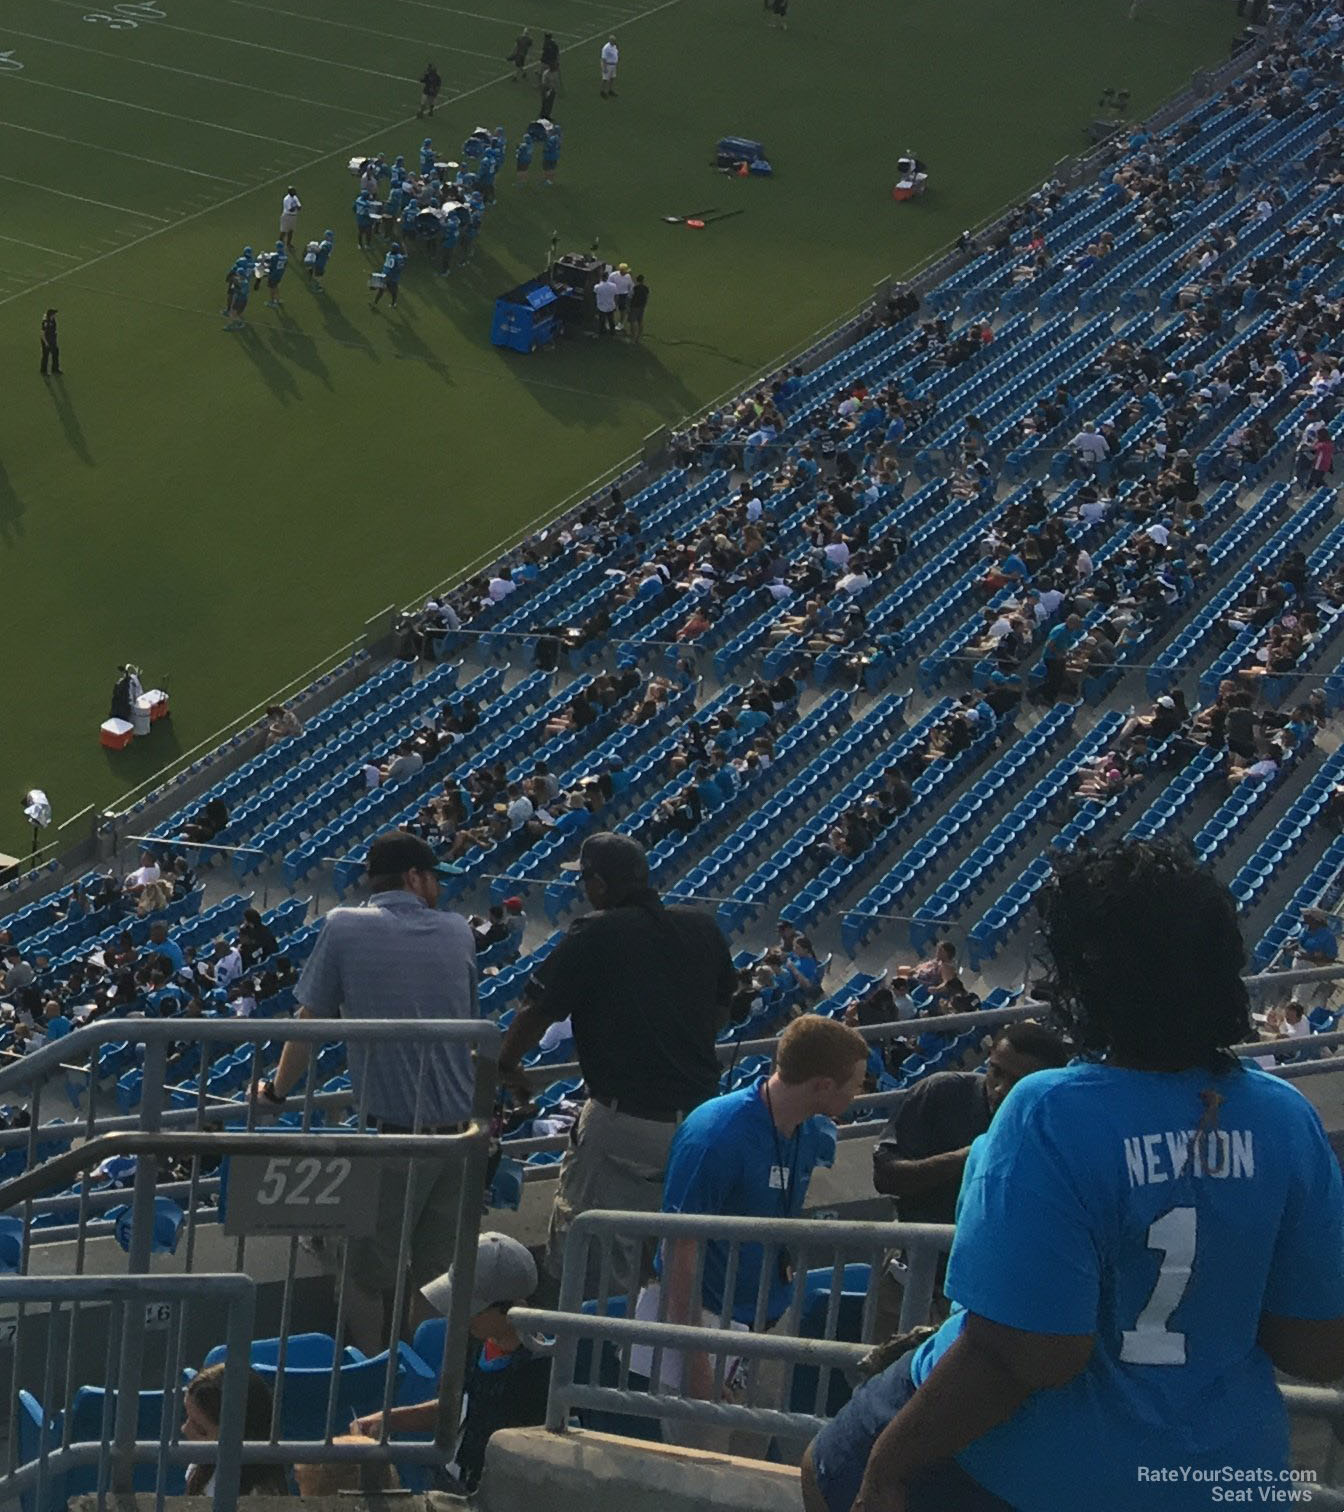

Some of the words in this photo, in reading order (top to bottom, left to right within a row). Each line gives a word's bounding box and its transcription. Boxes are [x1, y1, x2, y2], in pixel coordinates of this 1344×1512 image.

[82, 1, 167, 30] 30
[257, 1158, 352, 1205] 522
[1124, 1130, 1255, 1188] NEWTON
[1119, 1207, 1197, 1366] 1
